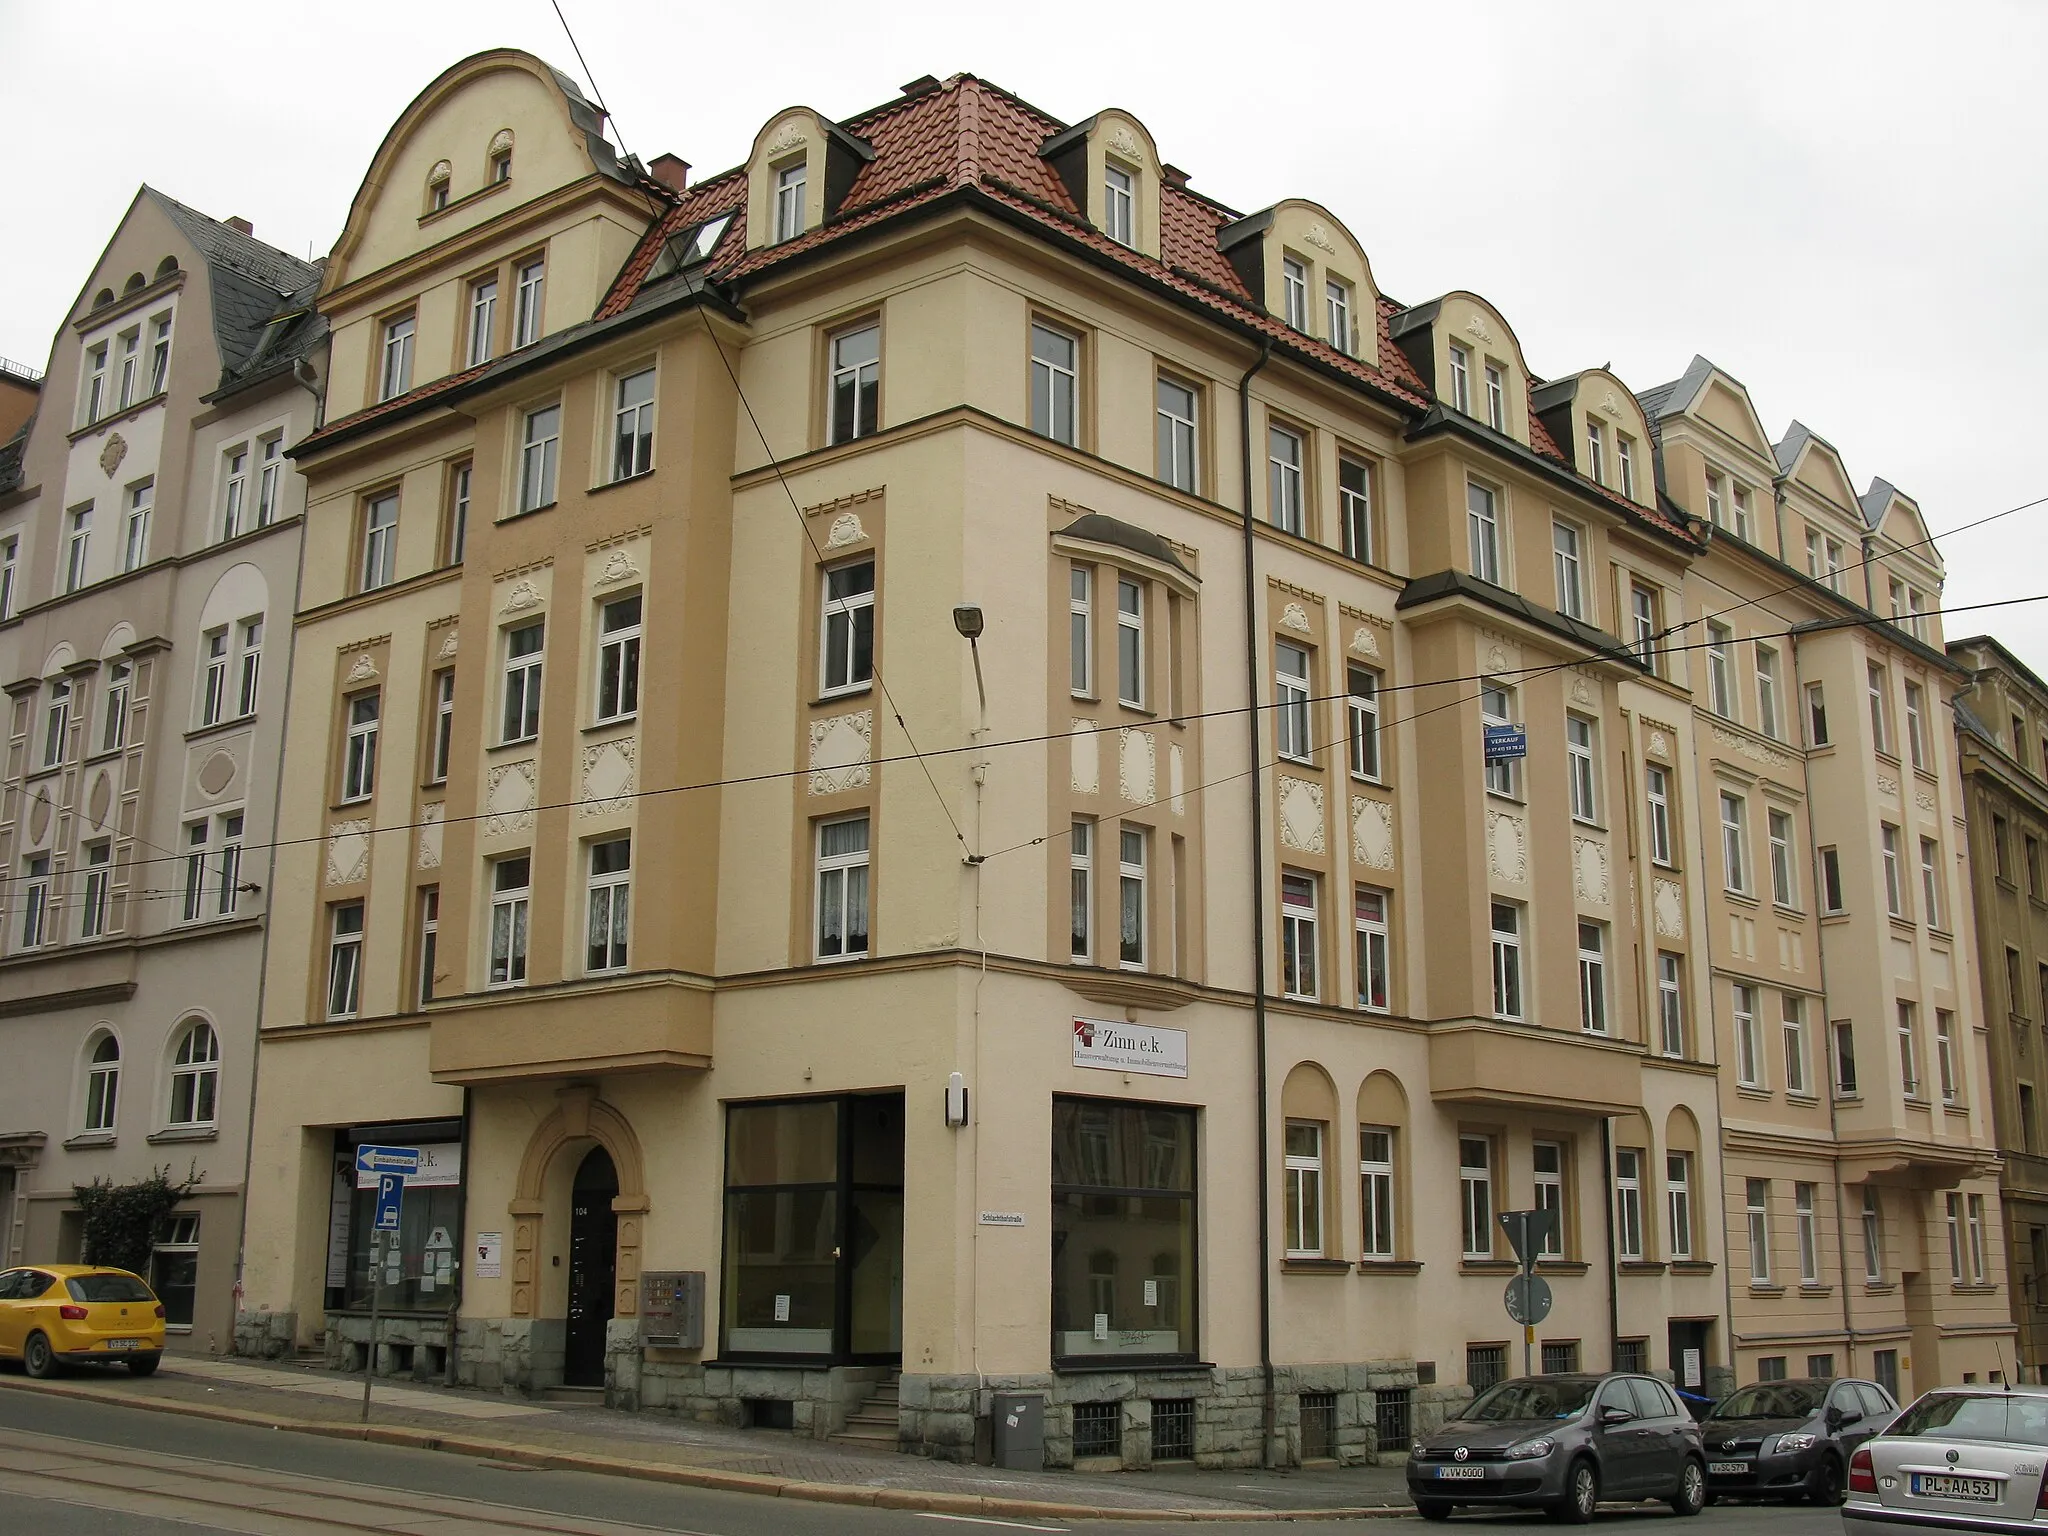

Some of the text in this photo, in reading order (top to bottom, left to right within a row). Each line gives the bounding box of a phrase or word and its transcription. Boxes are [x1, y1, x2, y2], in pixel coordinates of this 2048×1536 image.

[1490, 737, 1519, 745] VERKAUF
[1103, 1030, 1164, 1054] Zinn e.k.
[1074, 1050, 1120, 1064] Hausverwaltung
[1127, 1056, 1187, 1070] Immobilienvermittlung
[374, 1155, 414, 1165] Einbahnstraße
[382, 1178, 394, 1200] P
[575, 1207, 588, 1216] 104
[983, 1213, 1022, 1222] Schlachthofstraße
[1731, 1463, 1745, 1472] 579
[1440, 1468, 1483, 1478] V VW 6000
[1925, 1477, 1990, 1496] PL AA 53
